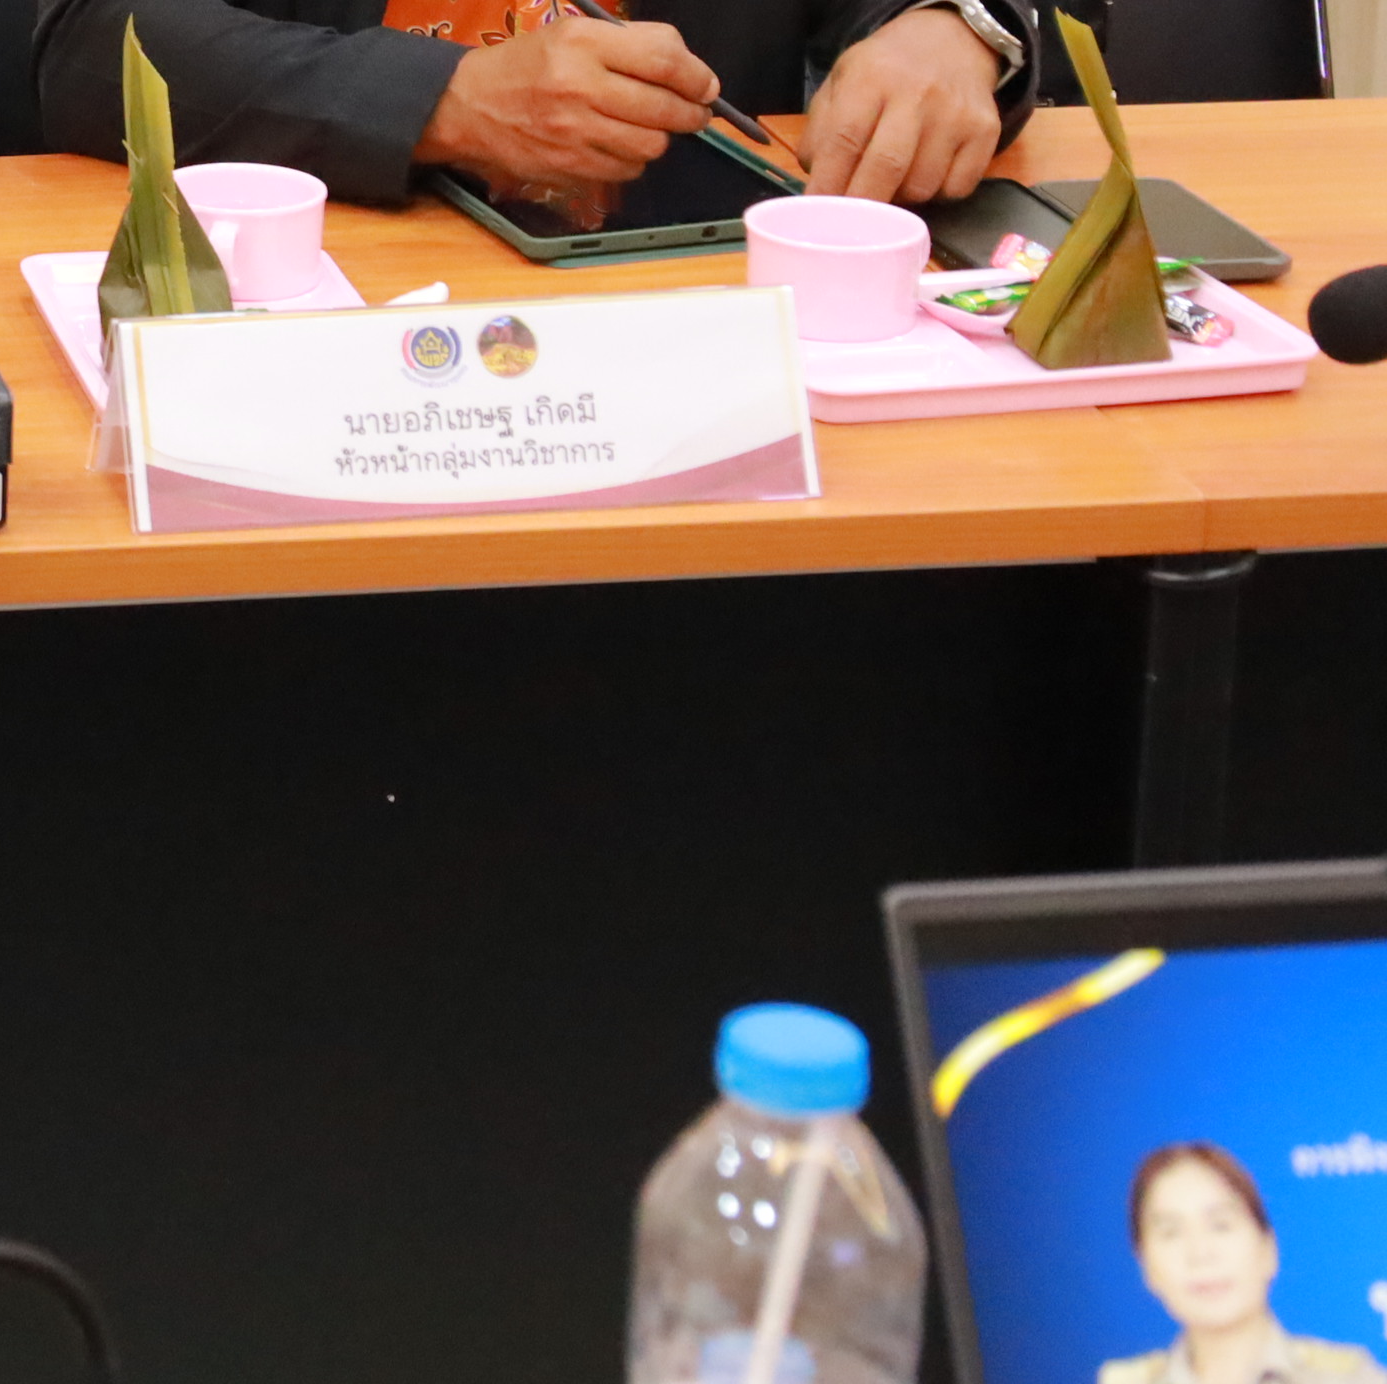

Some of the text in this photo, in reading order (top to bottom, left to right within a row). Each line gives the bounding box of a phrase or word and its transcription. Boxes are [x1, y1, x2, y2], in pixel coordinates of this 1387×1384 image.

[525, 393, 597, 426] เกิดมี
[335, 439, 616, 479] หัวหน้ากลุ่มงานวิชาการ
